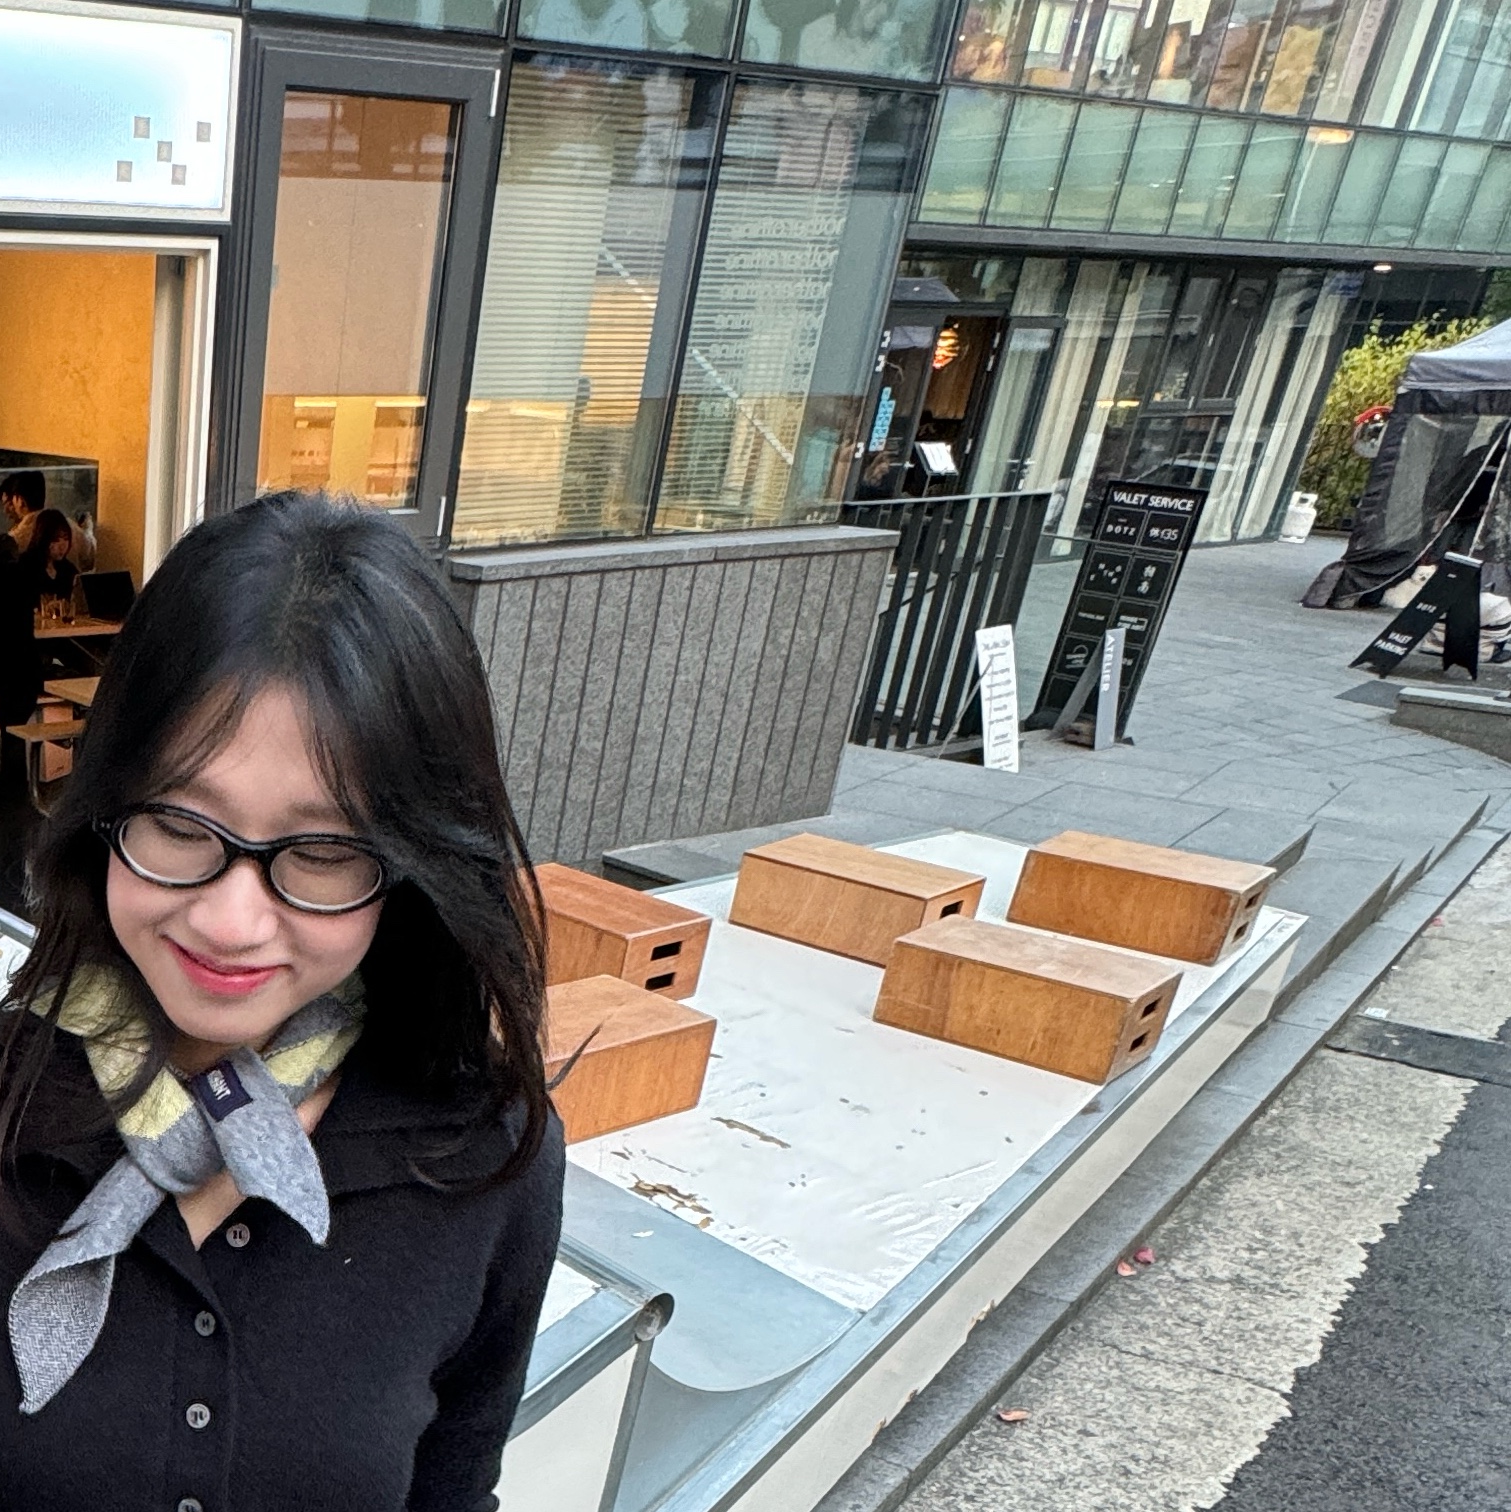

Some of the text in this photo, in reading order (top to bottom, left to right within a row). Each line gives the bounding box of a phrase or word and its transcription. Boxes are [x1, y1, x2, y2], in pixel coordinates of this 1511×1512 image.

[1113, 490, 1195, 511] VALET SERVICE
[1101, 634, 1116, 692] ATELIER
